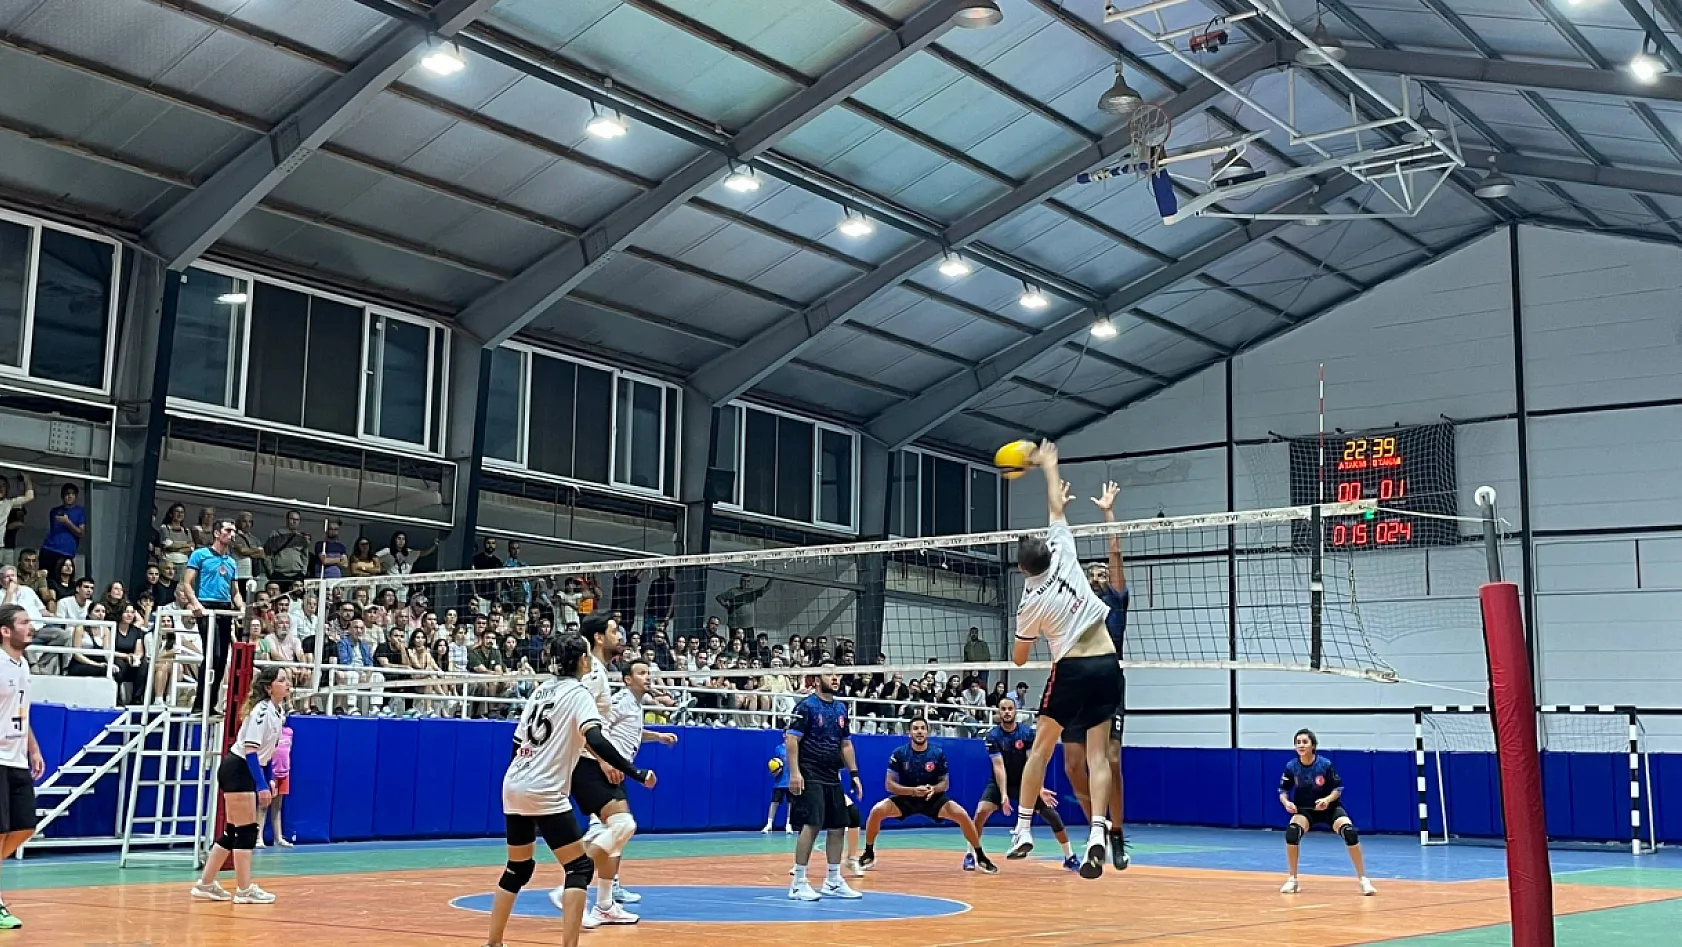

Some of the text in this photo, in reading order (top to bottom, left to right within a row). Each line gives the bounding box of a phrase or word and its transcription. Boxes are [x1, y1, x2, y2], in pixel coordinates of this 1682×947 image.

[1344, 437, 1395, 460] 22 39
[1337, 482, 1361, 502] 00
[1333, 522, 1411, 545] 015 024
